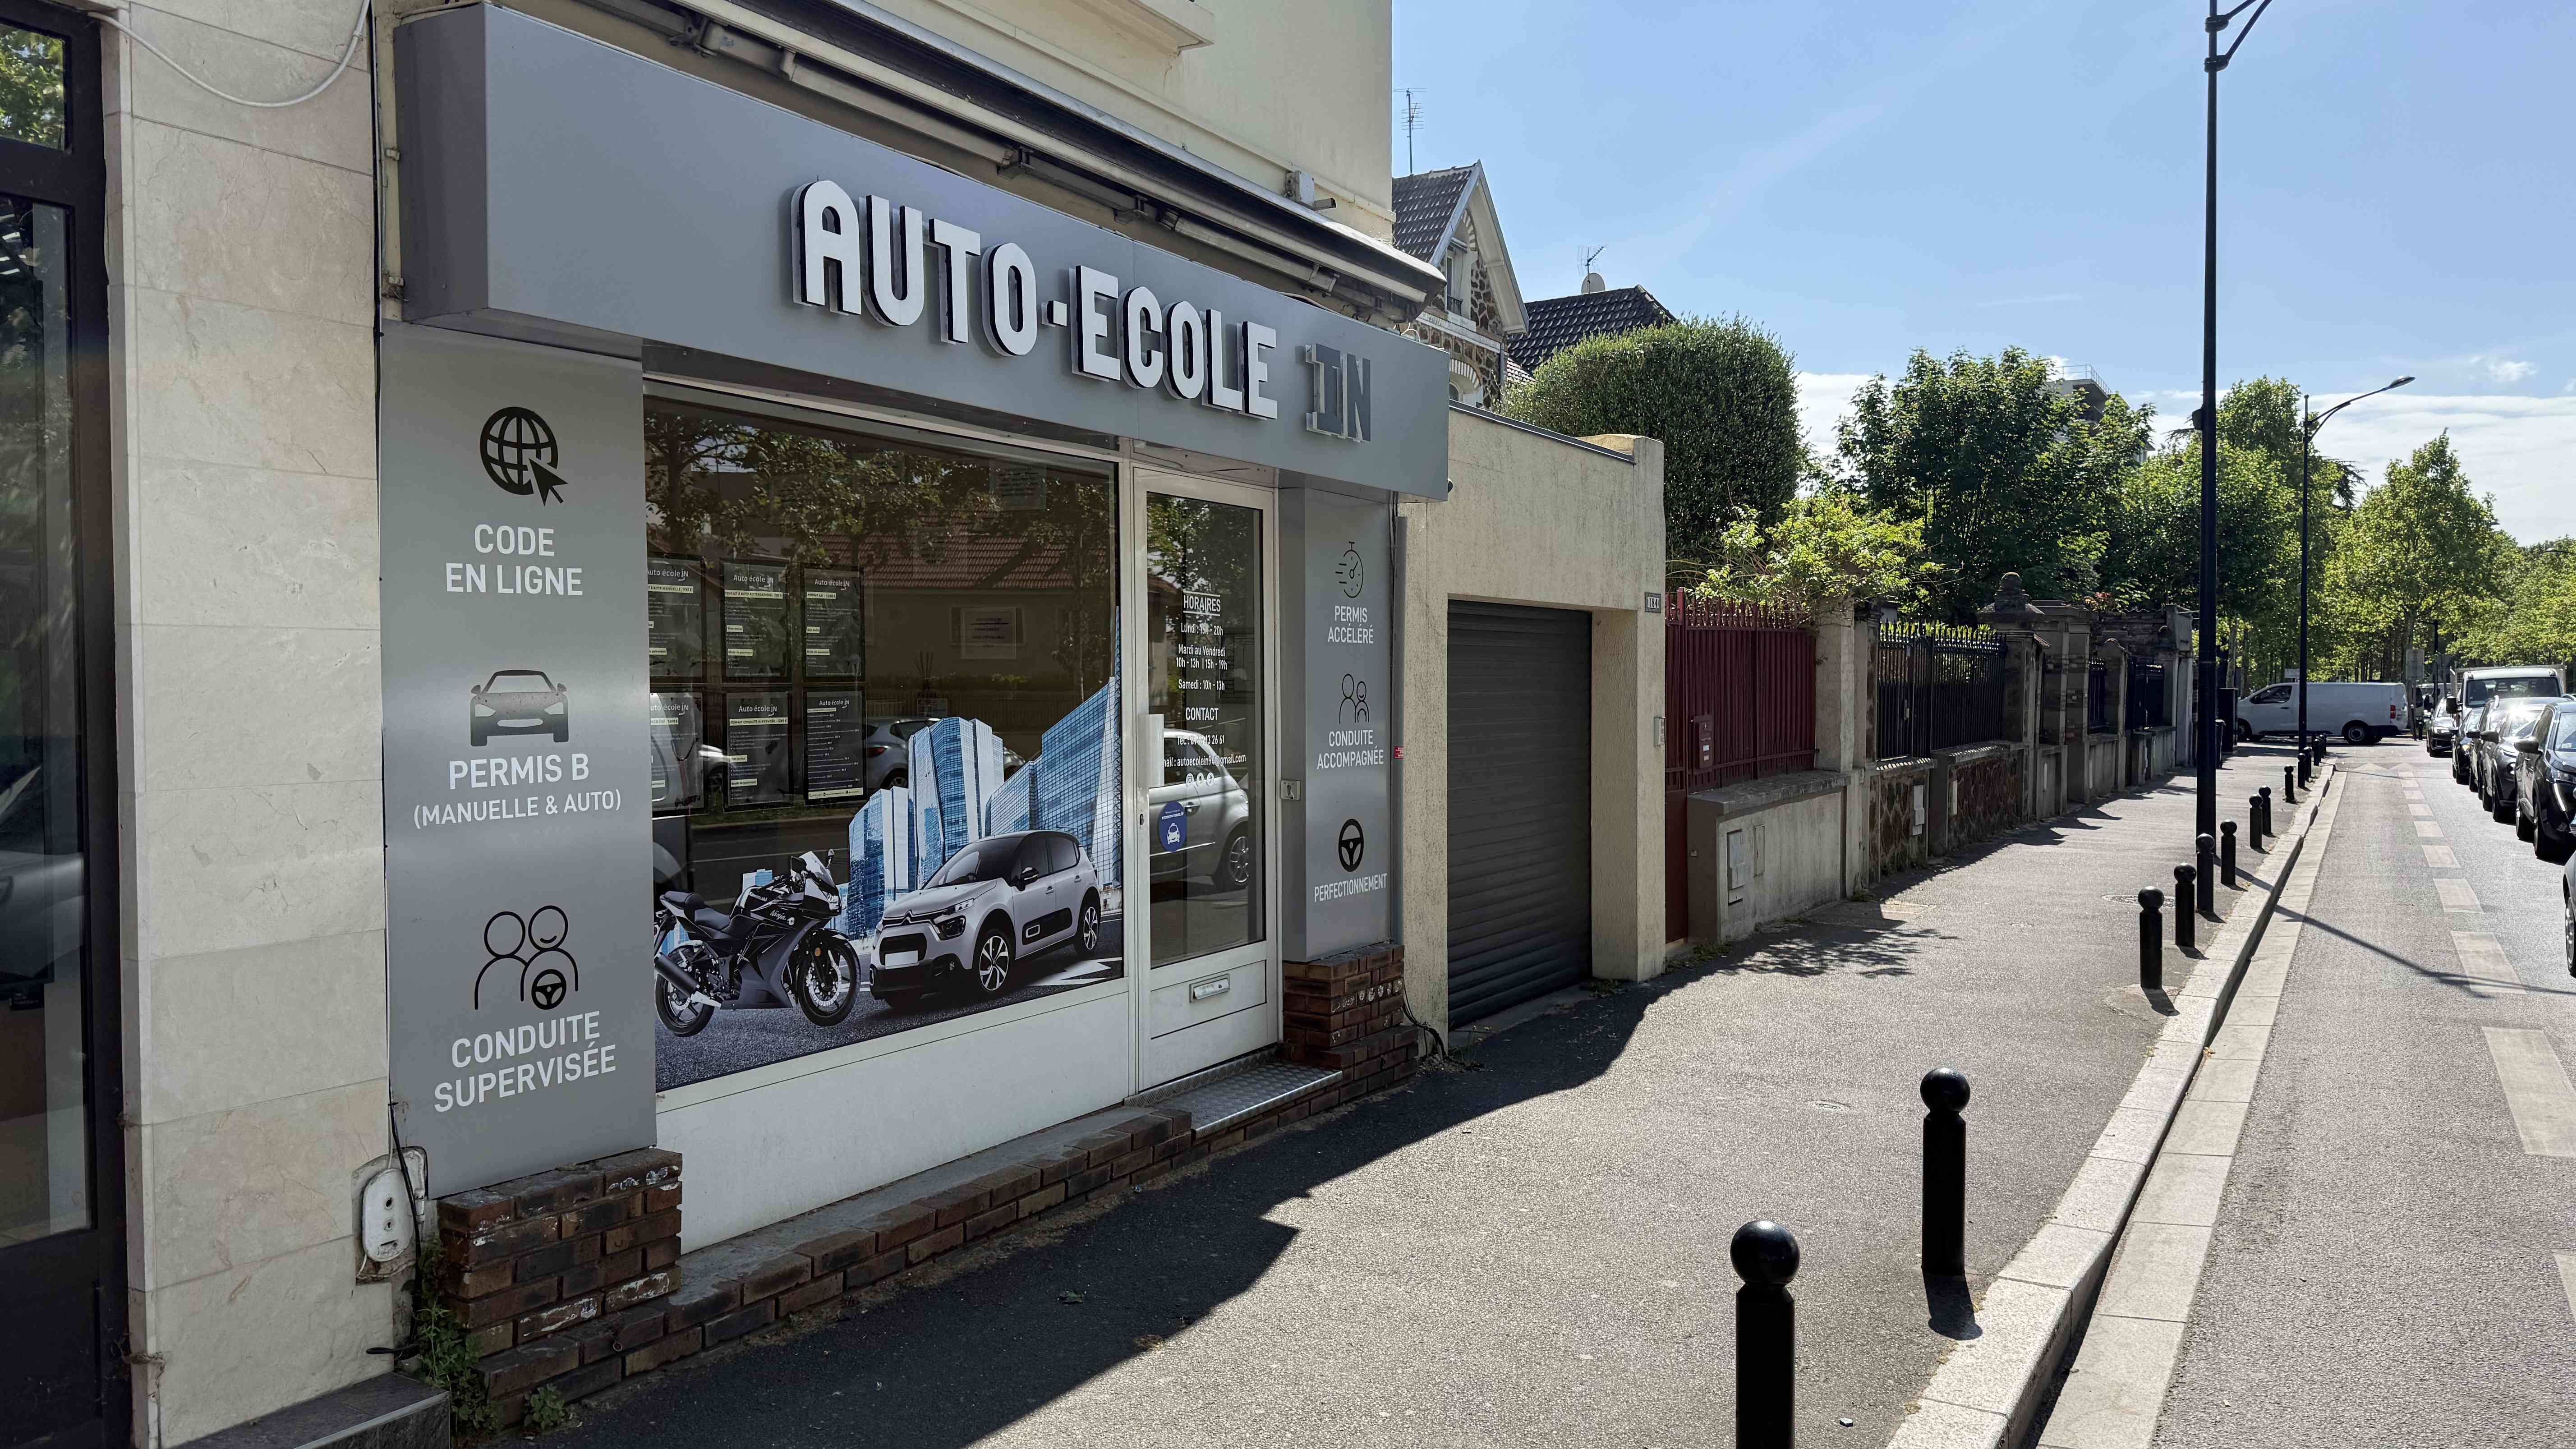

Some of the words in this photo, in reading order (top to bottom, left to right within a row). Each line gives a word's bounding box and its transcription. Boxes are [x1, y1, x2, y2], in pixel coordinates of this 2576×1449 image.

[793, 180, 1277, 419] AUTO-ECOLE
[475, 524, 555, 556] CODE
[446, 563, 486, 592] EN
[497, 565, 583, 595] LIGNE
[1183, 595, 1221, 612] HORAIRES
[1649, 598, 1657, 607] 184
[1335, 606, 1367, 622] PERMIS
[1181, 622, 1196, 633] Lundi
[1214, 626, 1223, 636] 20h
[1328, 623, 1374, 644] ACCÉLÉRÉ
[1178, 644, 1193, 655] Mardi
[1195, 647, 1201, 655] au
[1202, 645, 1225, 657] Vendredi
[1176, 657, 1185, 667] 10h
[1191, 658, 1199, 668] 13h
[1205, 659, 1214, 669] 15h
[1219, 660, 1227, 670] 19h
[1178, 679, 1199, 689] Samedi
[1203, 680, 1211, 690] 10h
[1216, 681, 1225, 690] 13h
[1186, 707, 1219, 721] CONTACT
[1212, 735, 1218, 745] 26
[1219, 735, 1224, 744] 61
[1329, 730, 1373, 747] CONDUITE
[1317, 745, 1384, 769] ACCOMPAGNÉE
[449, 754, 562, 789] PERMIS
[572, 753, 589, 780] B
[414, 796, 538, 829] (MANUELLE
[545, 795, 558, 814] &
[563, 789, 621, 813] AUTO)
[1315, 873, 1387, 902] PERFECTIONNEMENT
[452, 1011, 600, 1068] CONDUITE
[434, 1040, 616, 1113] SUPERVISÉE
